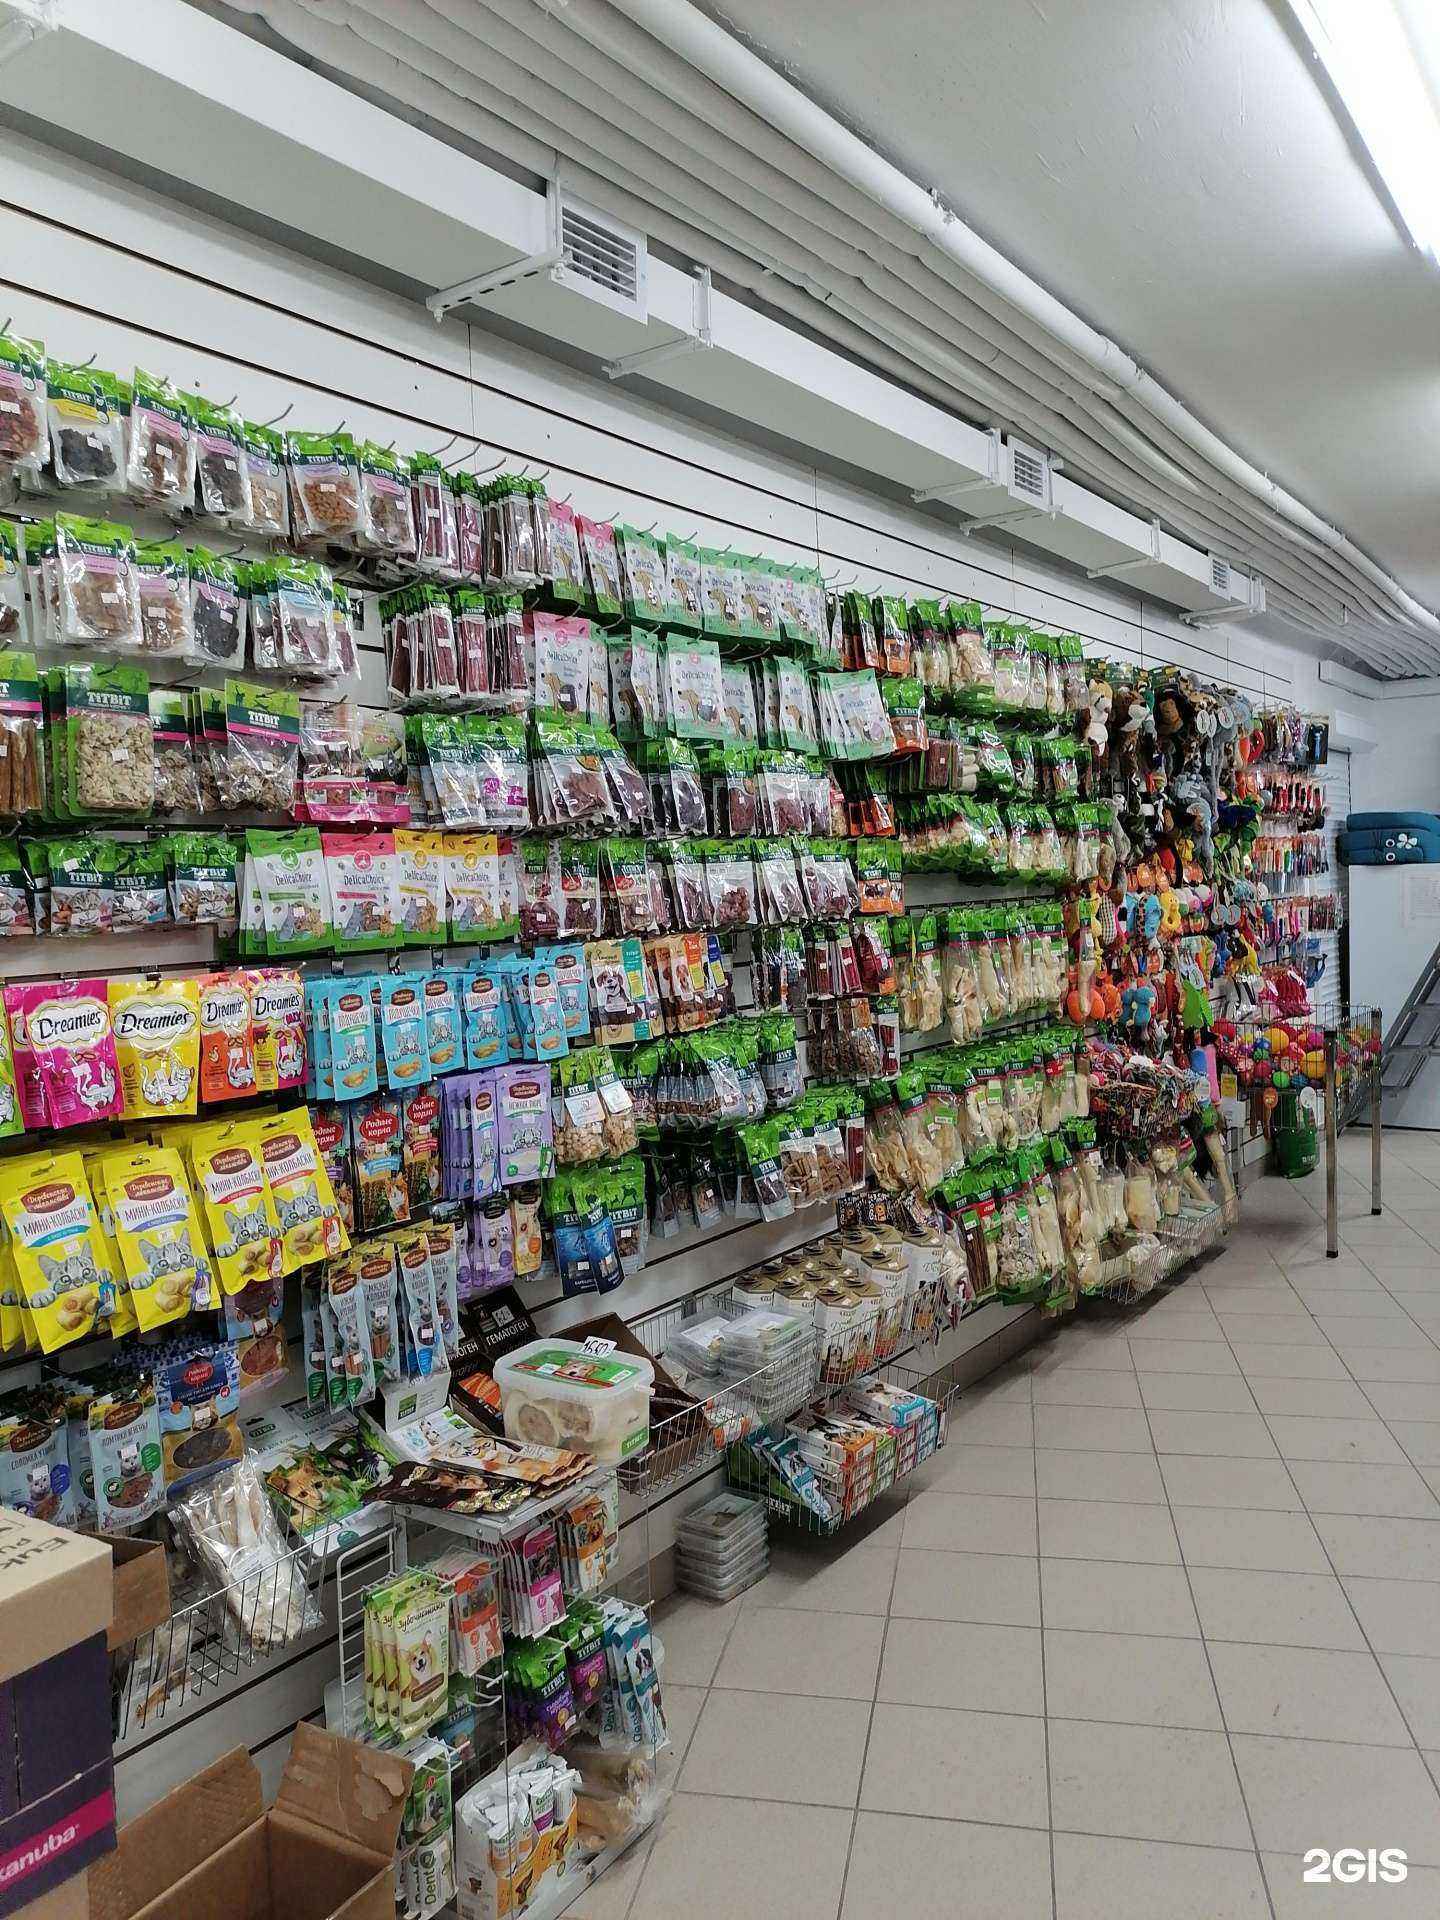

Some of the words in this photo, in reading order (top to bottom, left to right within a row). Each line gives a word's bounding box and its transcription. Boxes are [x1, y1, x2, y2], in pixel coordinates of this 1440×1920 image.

[254, 993, 300, 1016] Dreamies
[37, 1010, 101, 1040] Dreamies
[121, 1010, 190, 1034] Dreamies
[365, 1118, 393, 1129] Родные
[368, 1126, 391, 1137] корма
[211, 1170, 260, 1195] МИНИ-КОЛБАСК
[23, 1207, 87, 1237] МИНИ-КОЛБАСКИ
[485, 1319, 529, 1346] ГЕМАТОГЕН
